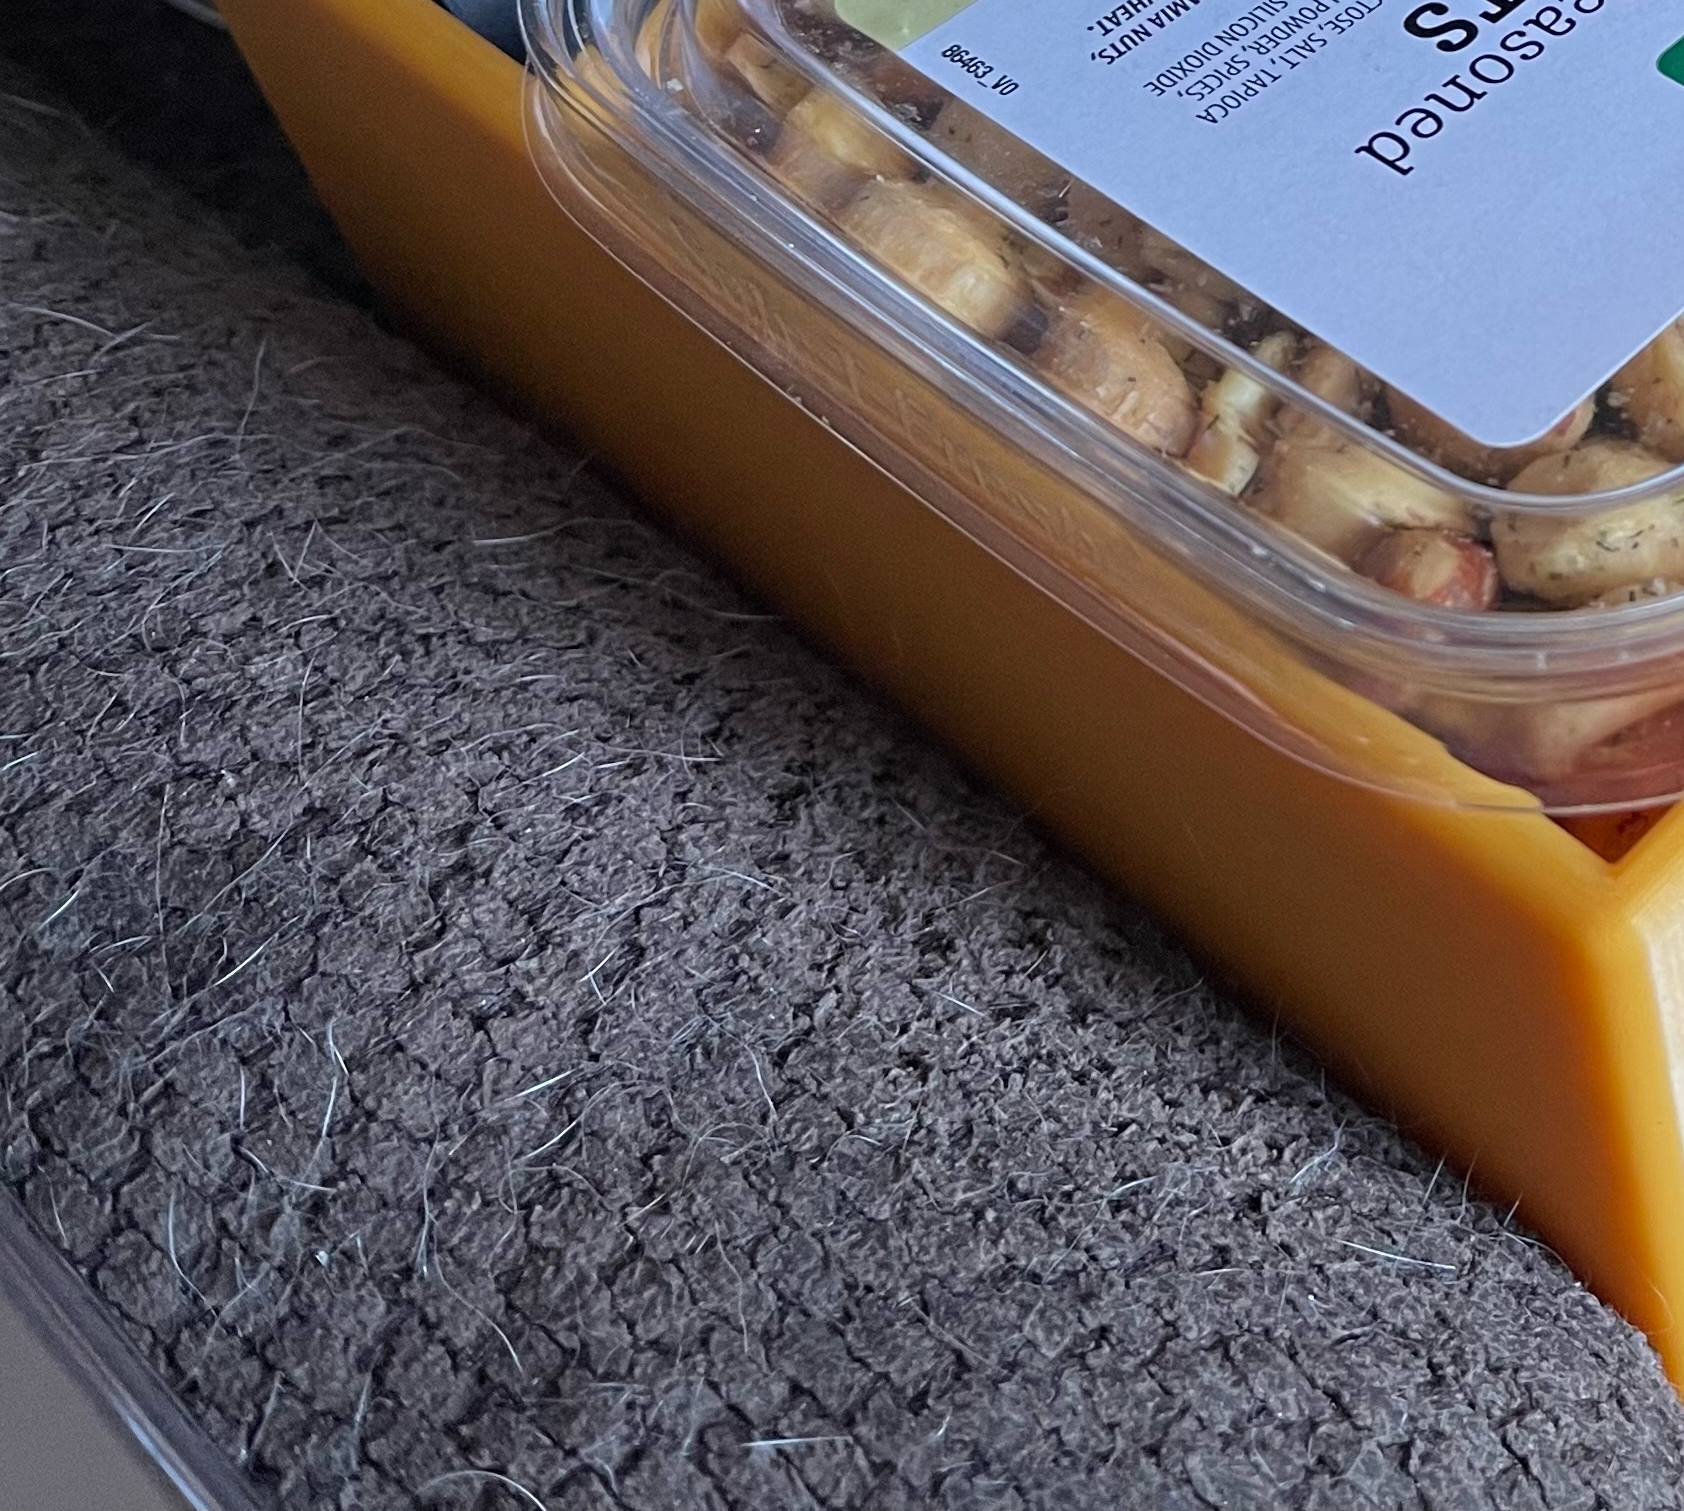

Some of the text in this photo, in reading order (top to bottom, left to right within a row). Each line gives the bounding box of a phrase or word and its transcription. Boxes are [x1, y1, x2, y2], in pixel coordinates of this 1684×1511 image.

[1089, 22, 1153, 66] NUTS,
[1141, 40, 1224, 97] DIOXIDE
[1268, 31, 1328, 70] SALT,
[1176, 52, 1251, 102] SPICES,
[1194, 67, 1283, 124] TAPIOCA
